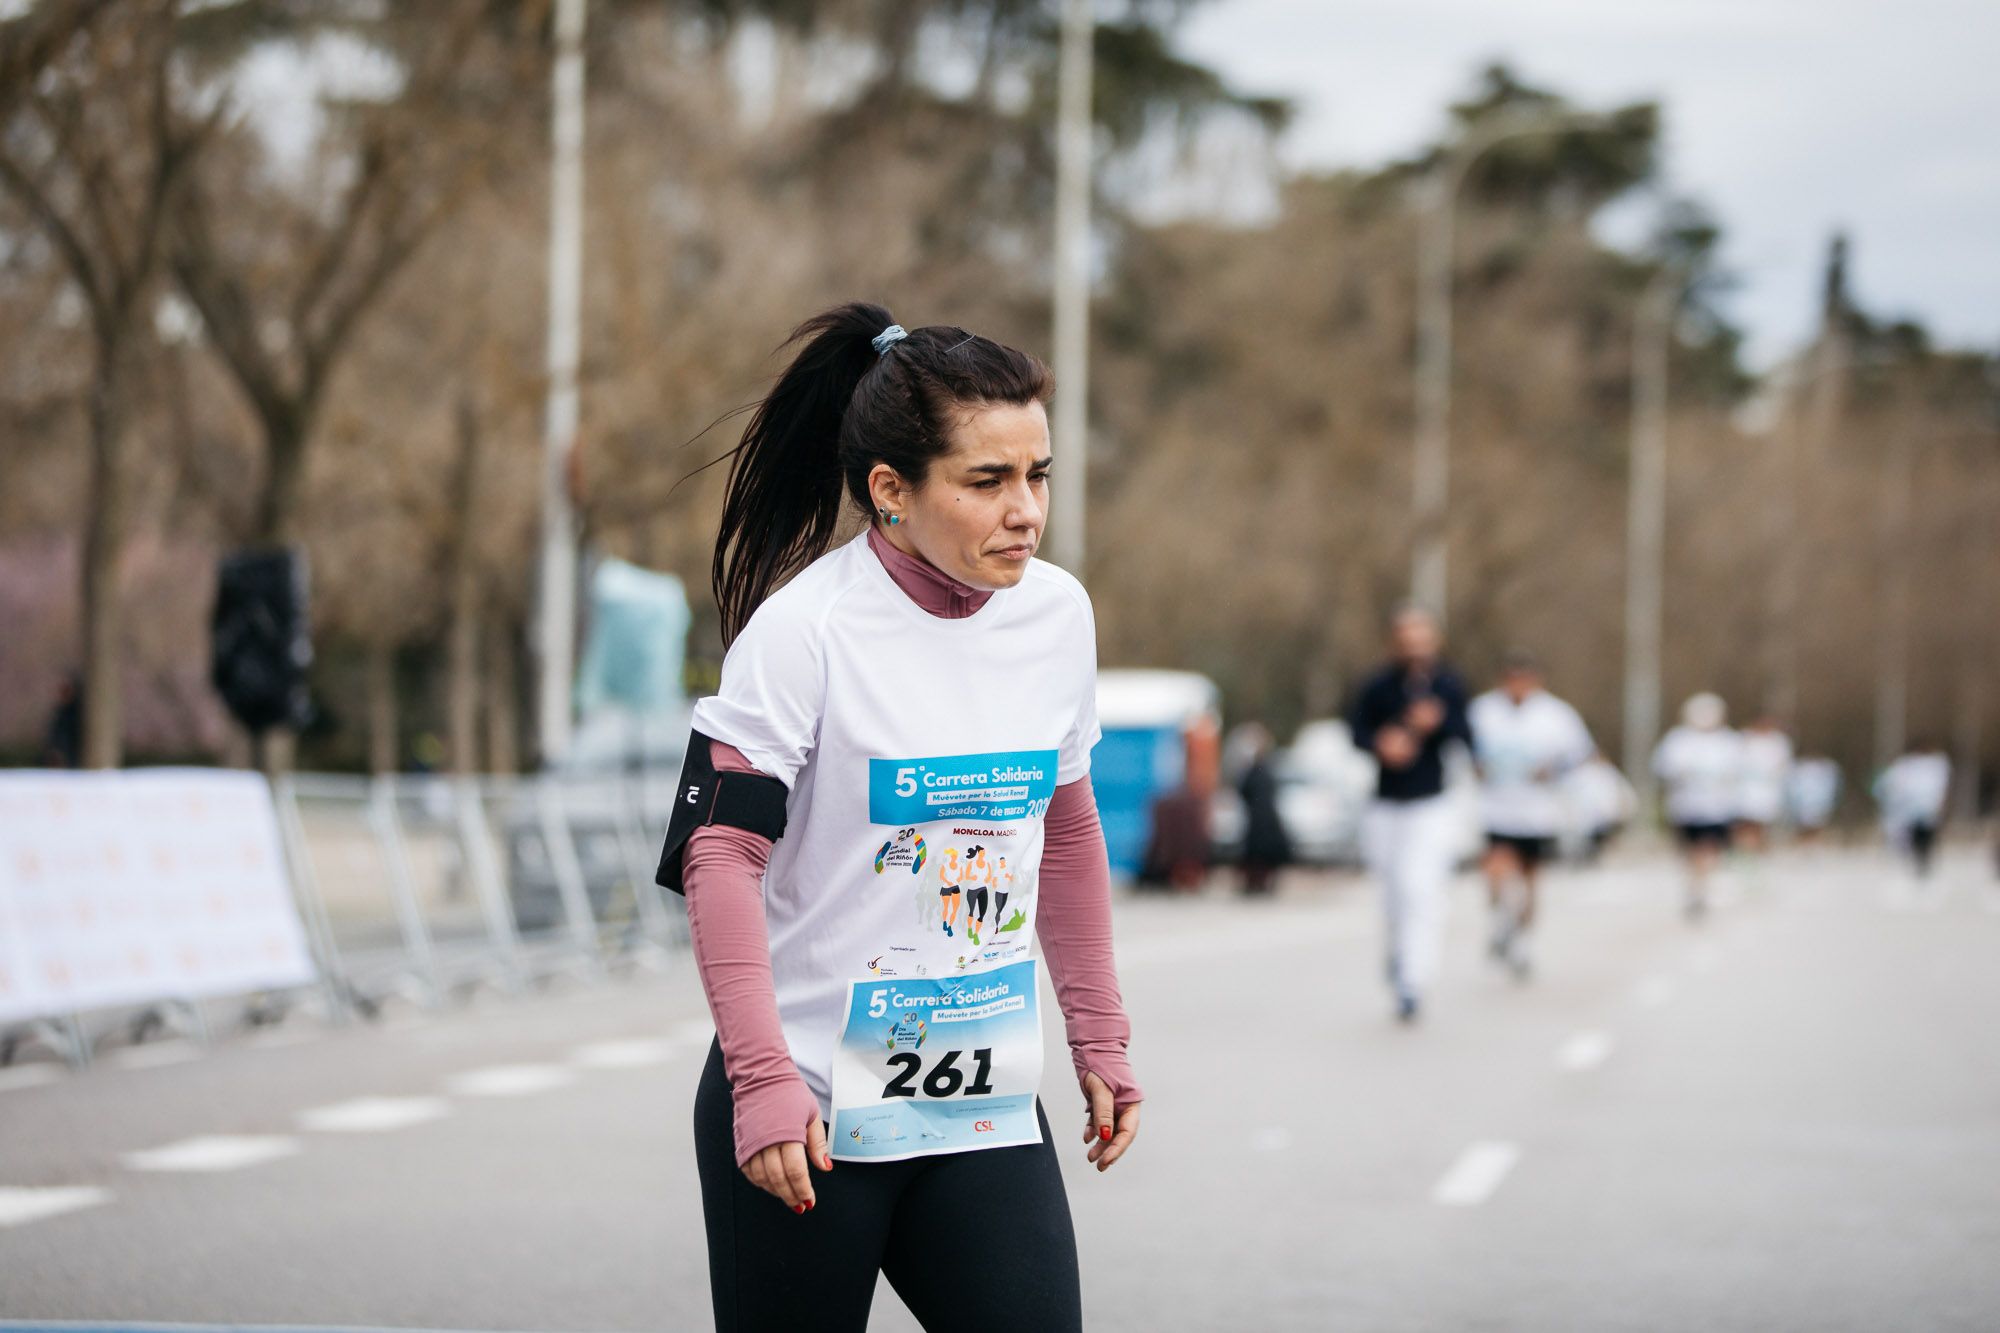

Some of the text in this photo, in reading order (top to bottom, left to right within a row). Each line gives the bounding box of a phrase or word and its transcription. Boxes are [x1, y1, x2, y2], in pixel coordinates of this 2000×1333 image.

[923, 772, 988, 788] Carrera
[991, 766, 1044, 783] Solidaria
[967, 792, 981, 801] por
[983, 790, 991, 798] la
[993, 790, 1009, 798] Salud
[937, 797, 1052, 819] Sábado 7 de marzo 202
[952, 828, 995, 837] MONCLOA
[891, 993, 953, 1008] Carrera
[957, 983, 1009, 1005] Solidaria
[969, 1010, 982, 1018] por
[882, 1048, 993, 1099] 261
[974, 1120, 995, 1132] CSL
